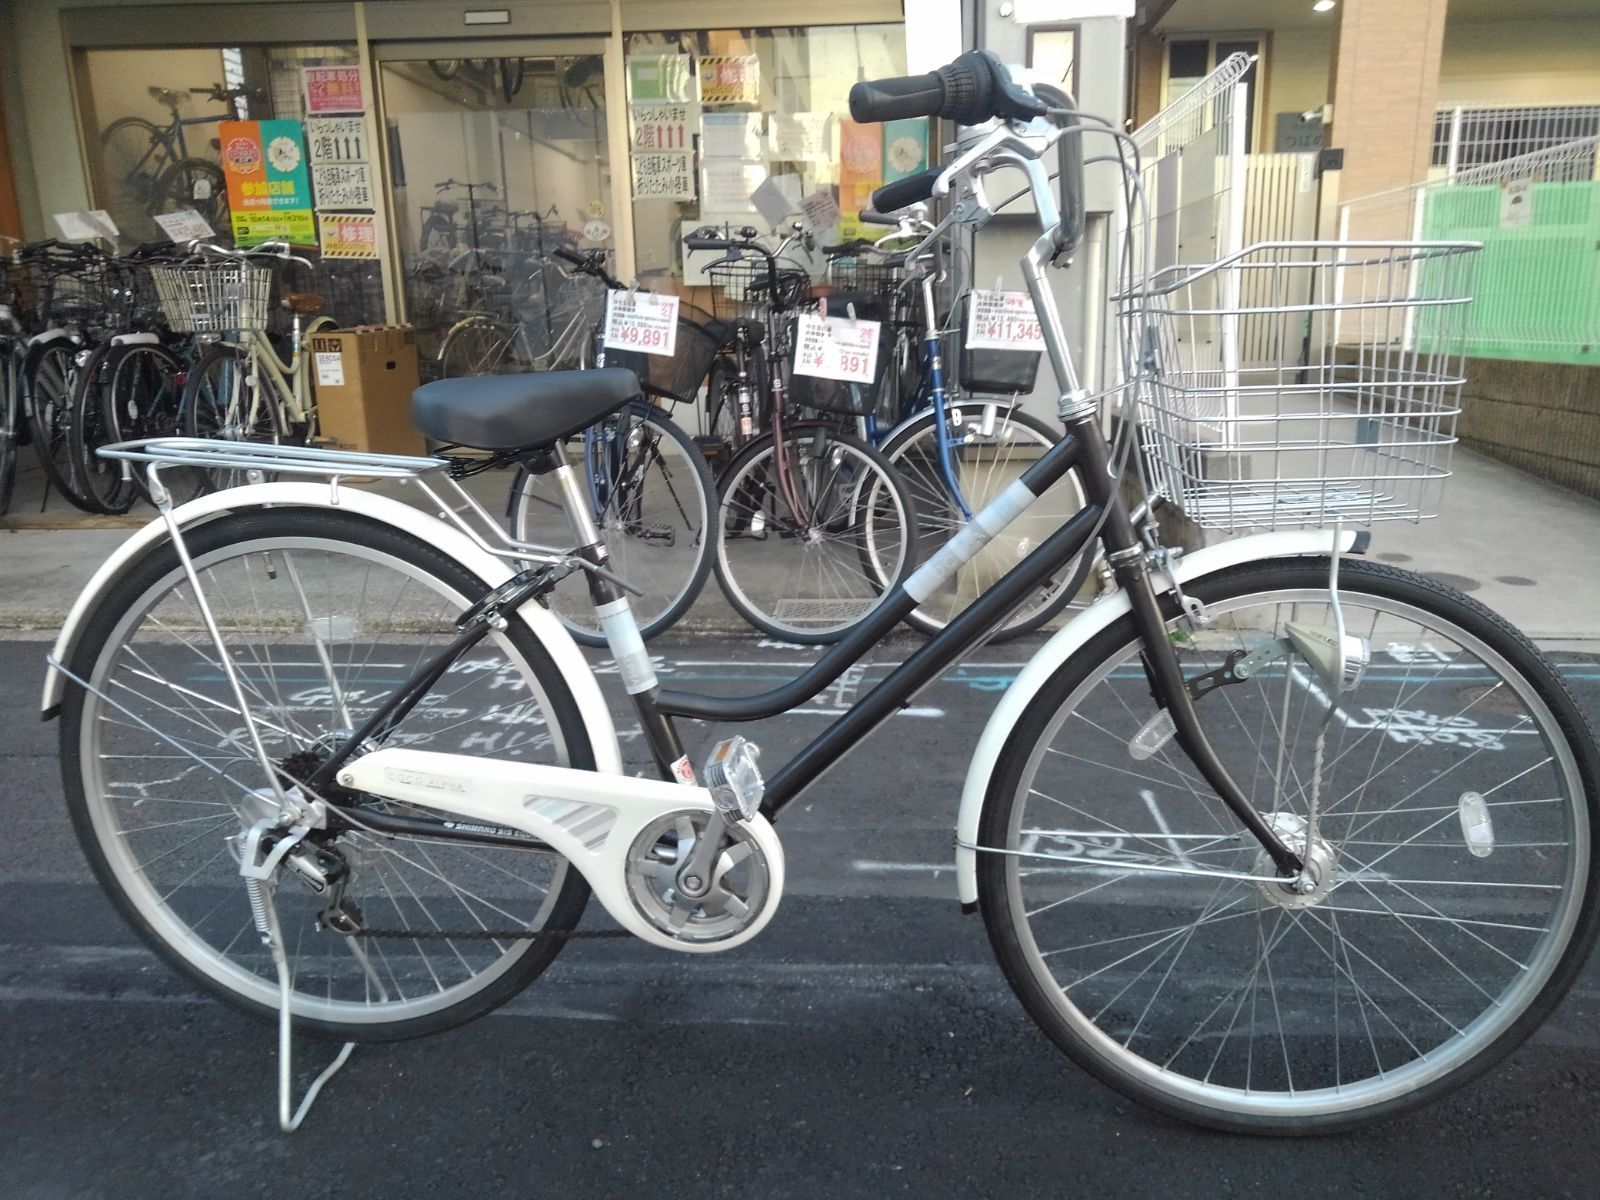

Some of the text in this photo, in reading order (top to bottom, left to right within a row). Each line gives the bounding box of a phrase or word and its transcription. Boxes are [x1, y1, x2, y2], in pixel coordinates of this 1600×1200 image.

[633, 107, 686, 121] いらっしゃいませ
[341, 225, 375, 243] 修理
[620, 326, 669, 348] ¥9,891
[987, 321, 1042, 341] ¥11,345
[427, 778, 467, 793] ALPHA
[455, 823, 497, 834] SHIMANO
[497, 827, 513, 836] SIS
